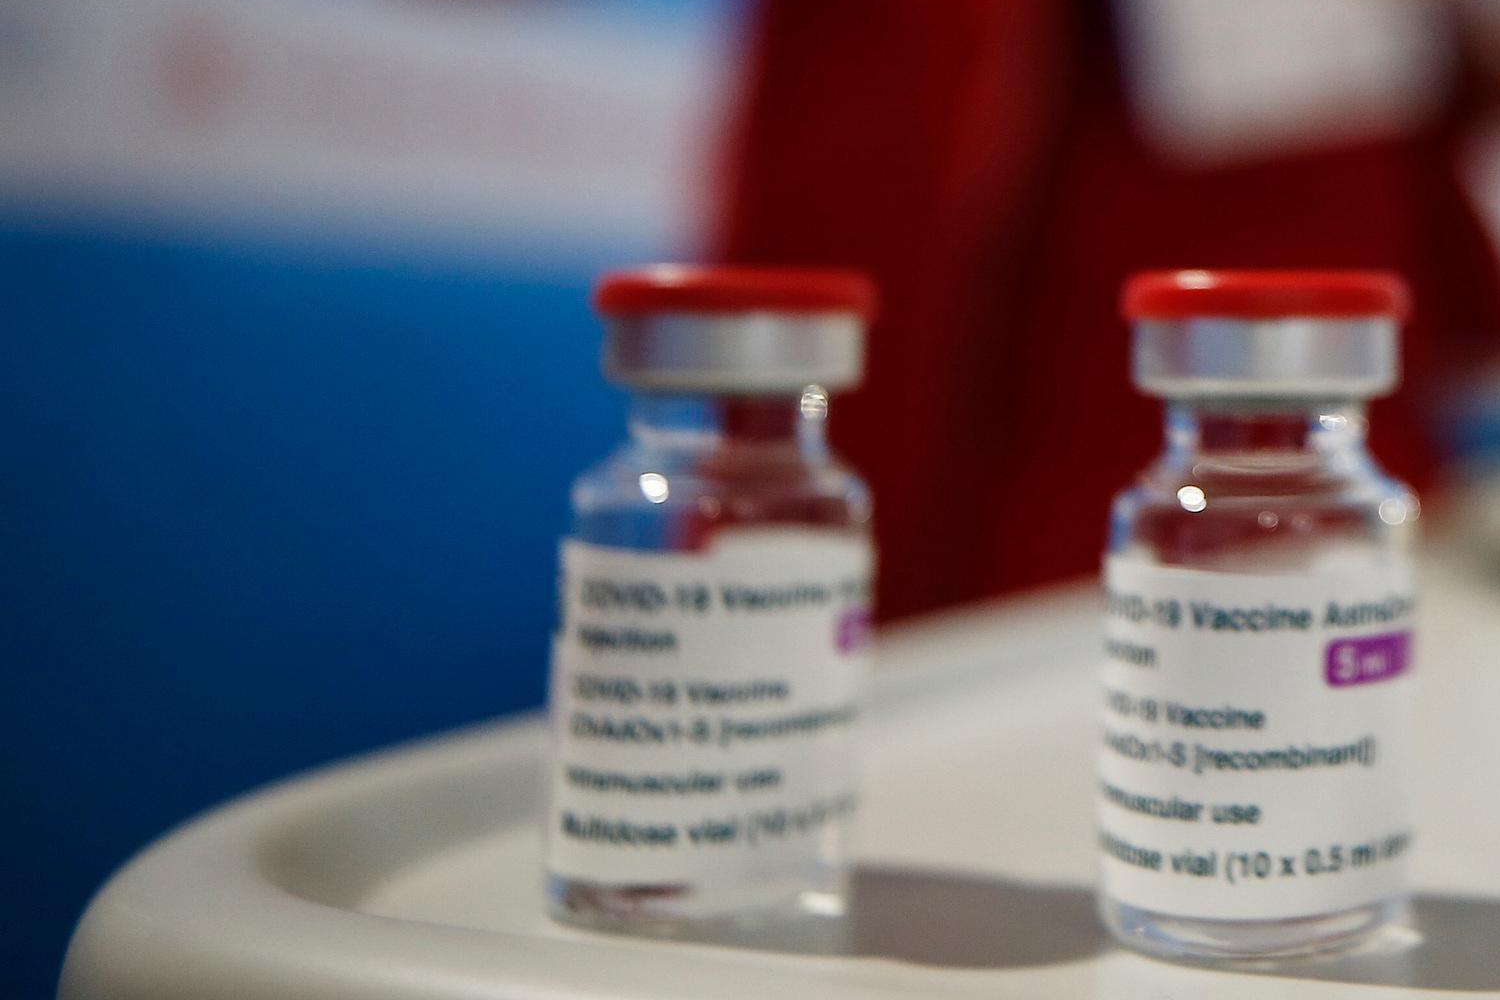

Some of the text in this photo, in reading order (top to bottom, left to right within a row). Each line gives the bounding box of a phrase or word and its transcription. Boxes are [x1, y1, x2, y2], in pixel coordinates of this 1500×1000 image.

[1189, 600, 1313, 632] Vaccine
[1165, 700, 1266, 730] Vaccine
[1211, 804, 1260, 825] use
[1225, 851, 1271, 885] (10
[1280, 856, 1296, 877] x
[1305, 846, 1343, 876] 0.5
